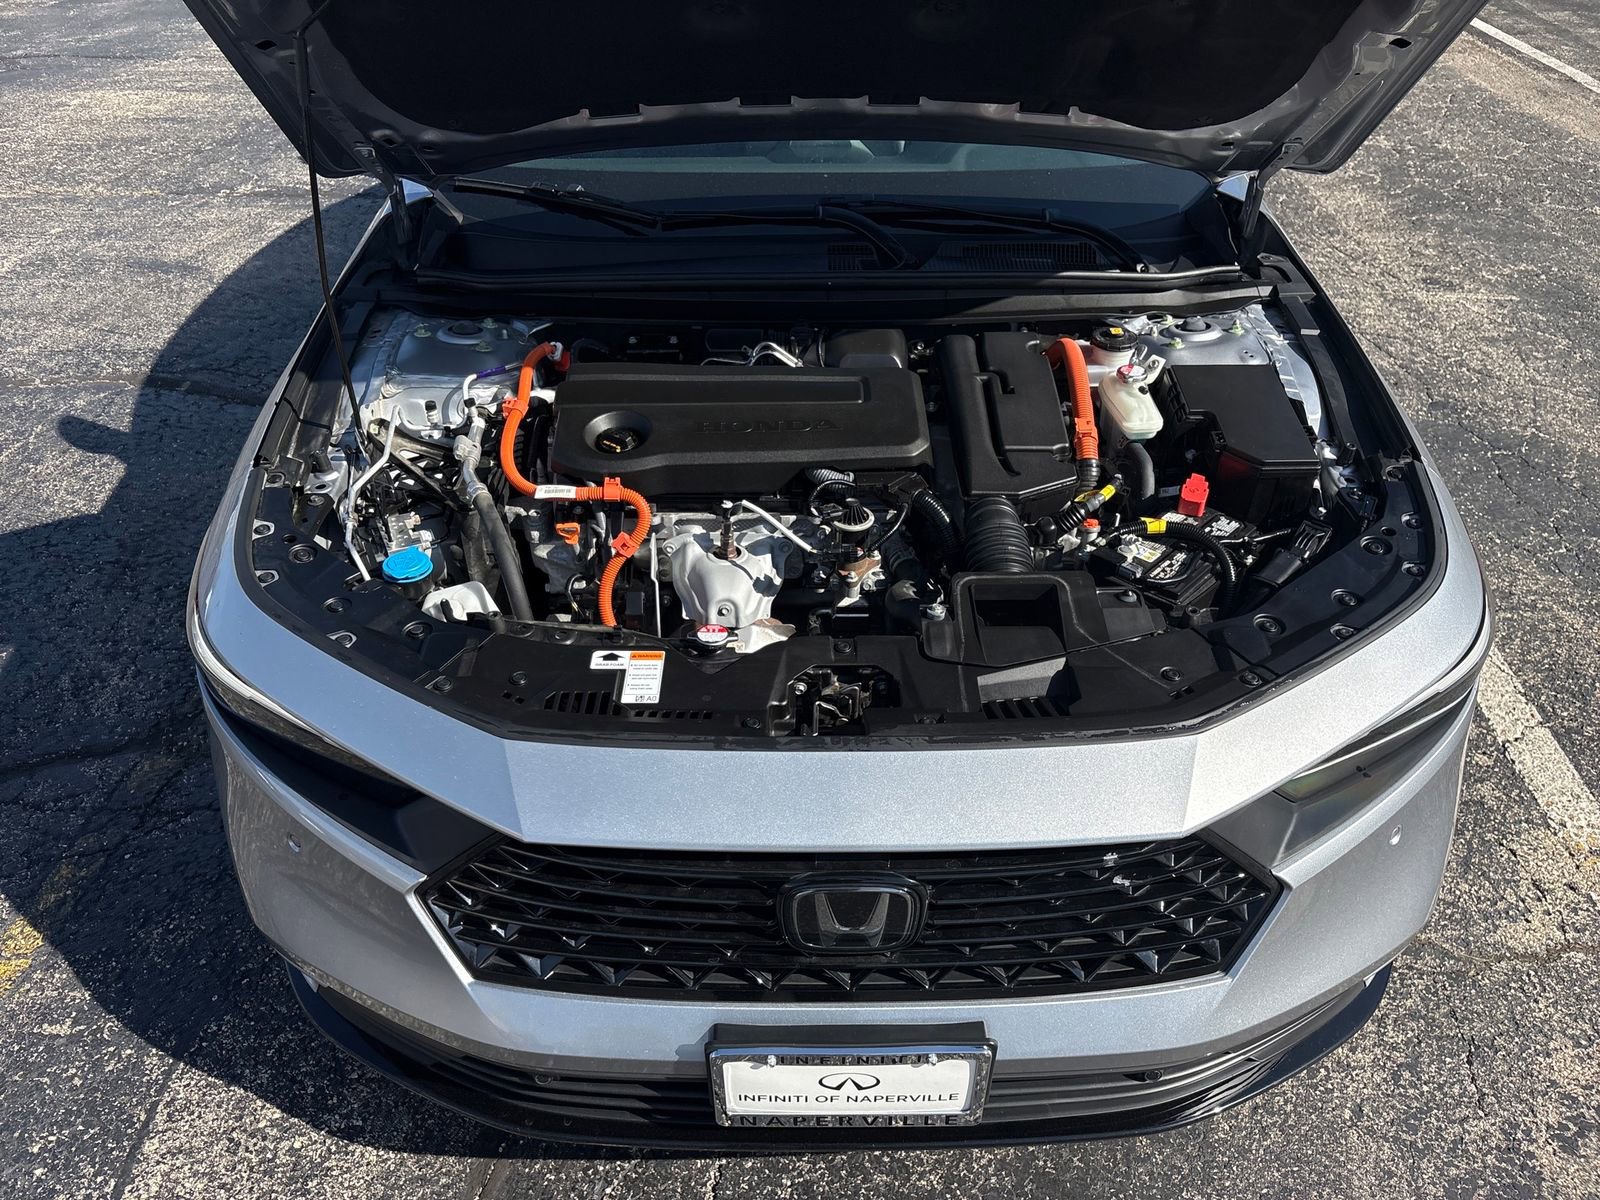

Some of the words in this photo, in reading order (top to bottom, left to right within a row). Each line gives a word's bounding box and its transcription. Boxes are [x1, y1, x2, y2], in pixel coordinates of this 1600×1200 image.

[696, 419, 843, 433] HONDA
[780, 1055, 922, 1065] INFINITI
[738, 1094, 809, 1103] INFINITI
[815, 1094, 841, 1103] OF
[847, 1093, 960, 1103] NAPERVILLE
[740, 1115, 959, 1126] NAPERVILLE
